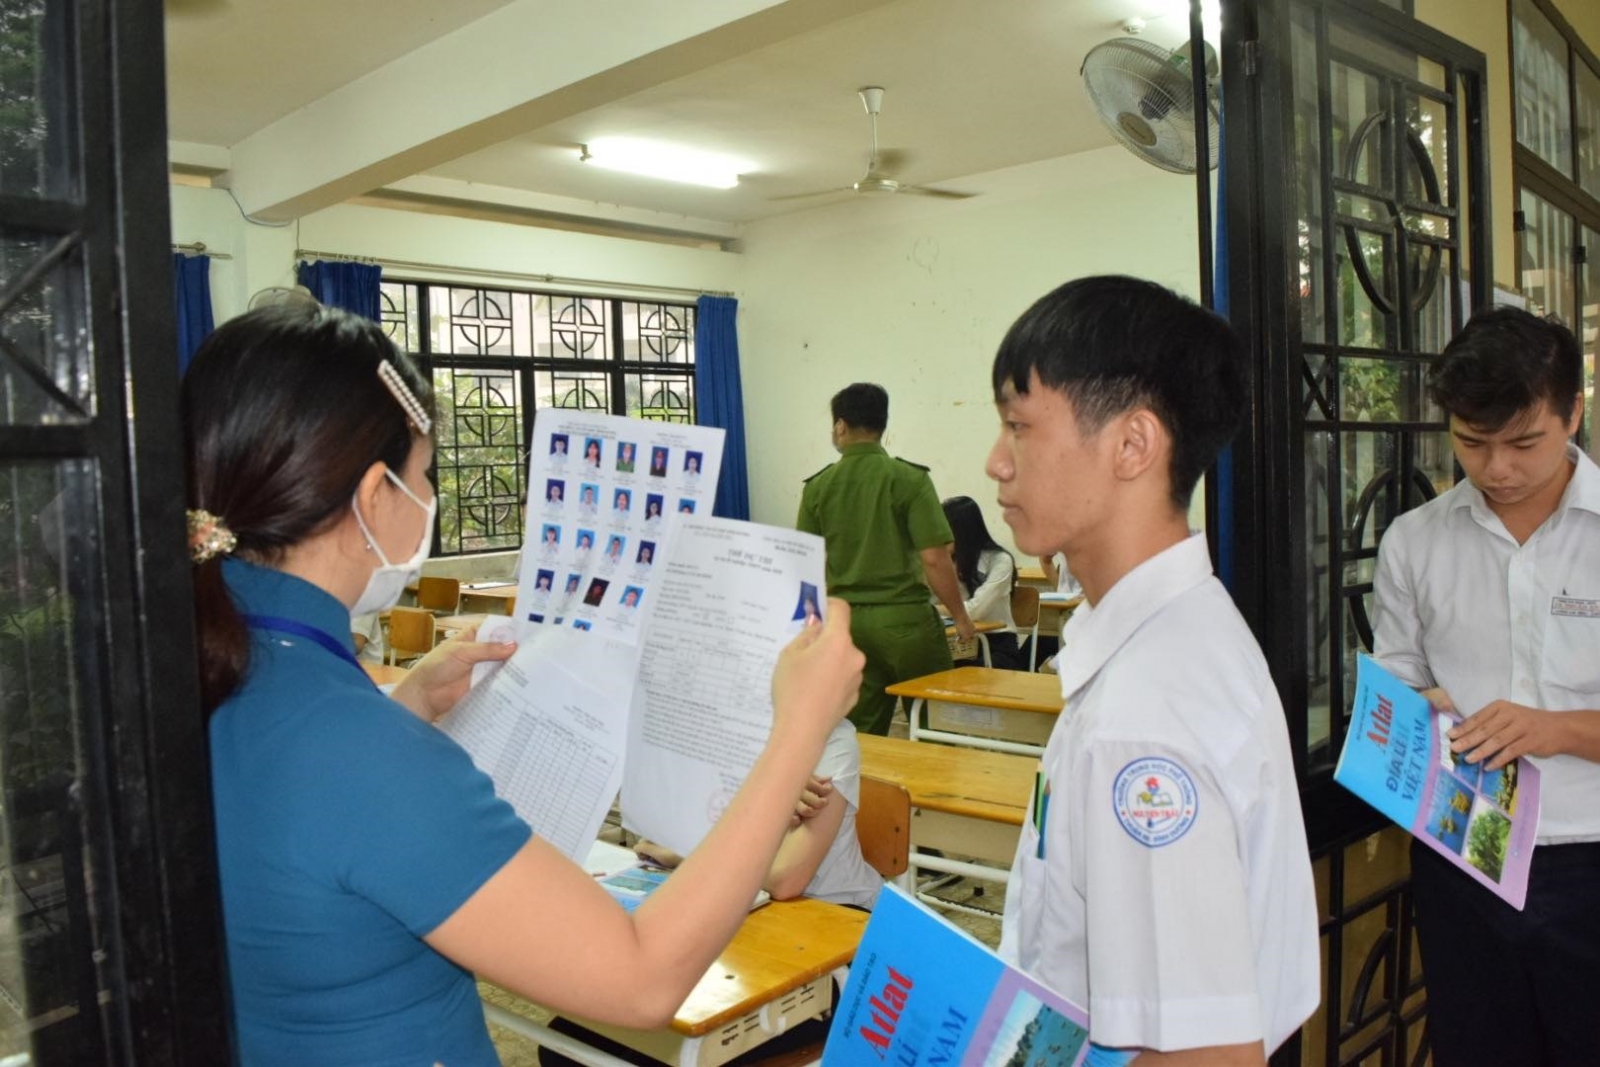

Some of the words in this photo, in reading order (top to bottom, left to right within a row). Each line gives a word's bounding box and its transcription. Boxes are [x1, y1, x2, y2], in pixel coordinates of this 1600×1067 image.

[1366, 692, 1393, 755] Atlat
[1402, 760, 1421, 800] VIỆT
[1412, 719, 1427, 760] NAM
[860, 965, 914, 1060] Atlat
[928, 1006, 968, 1067] NAM
